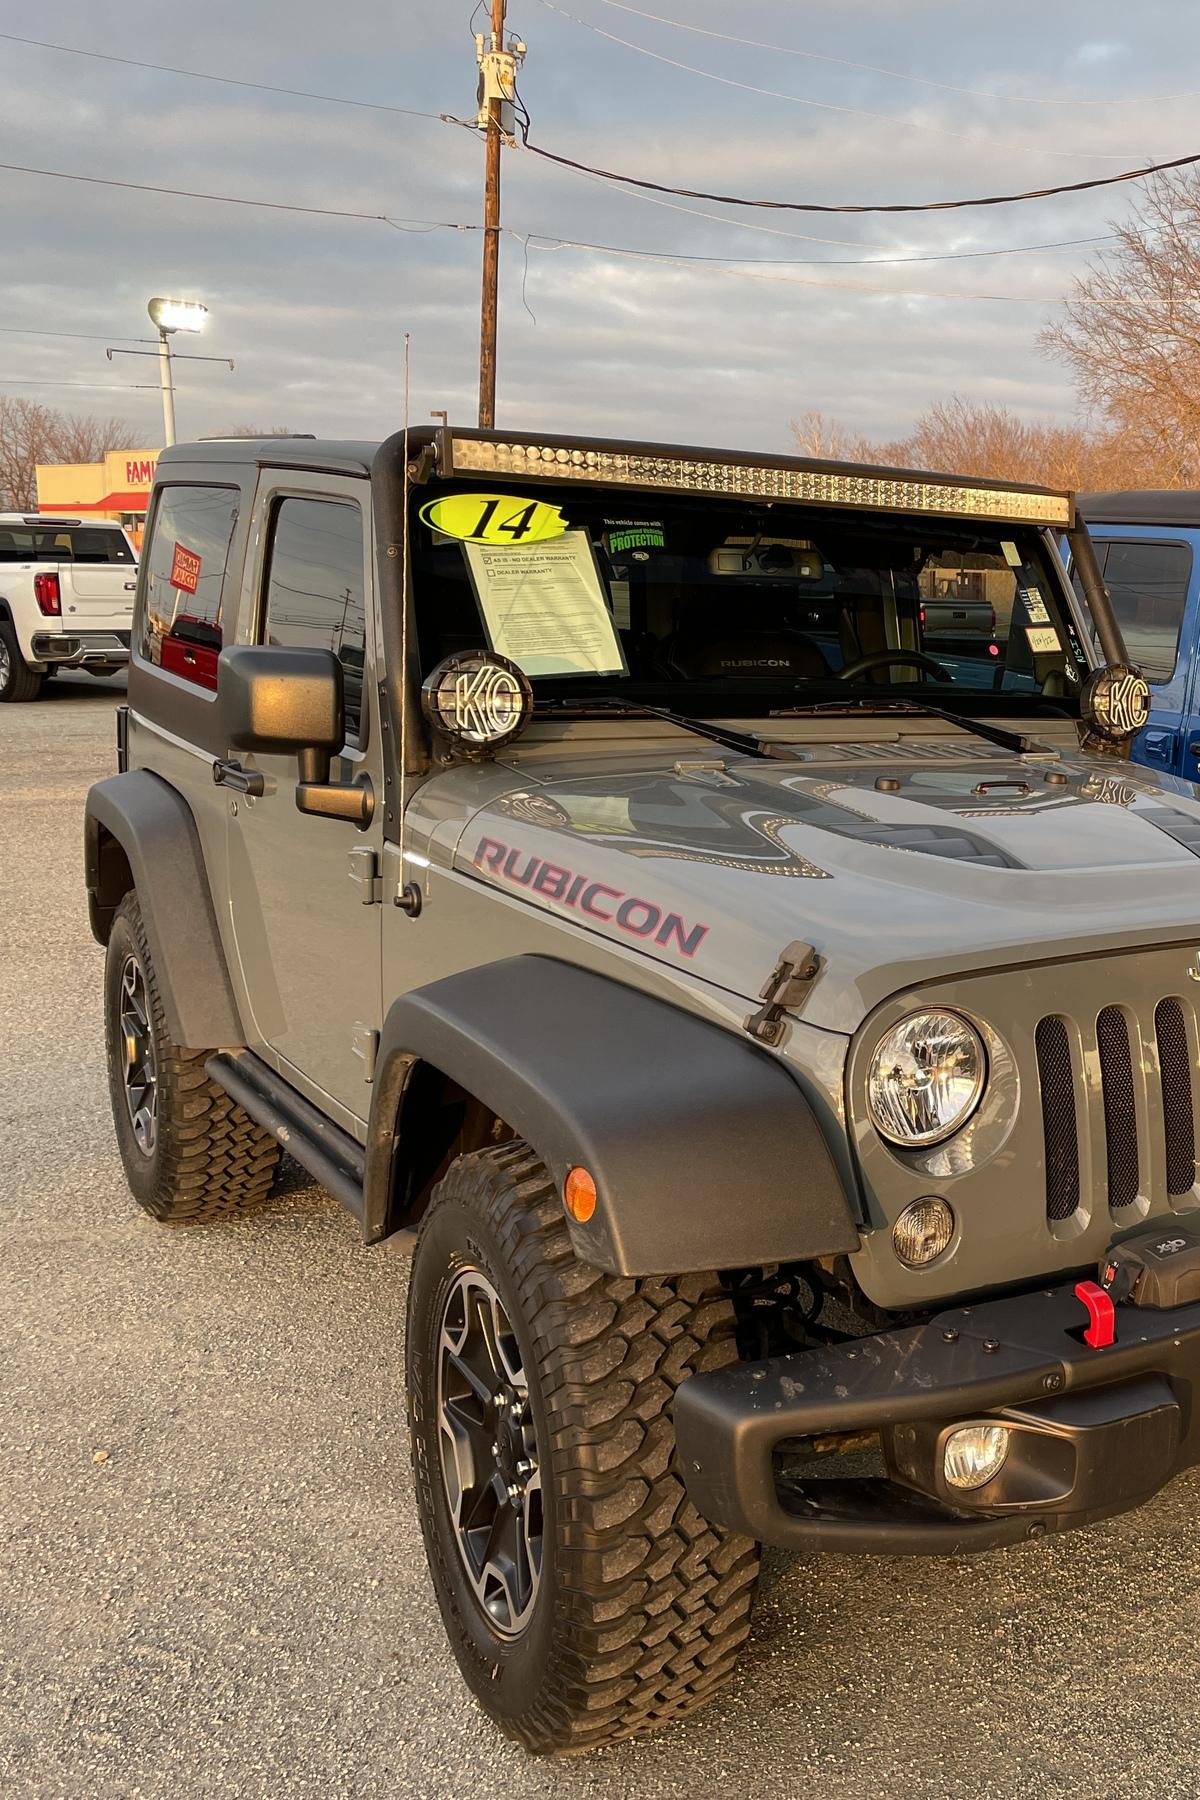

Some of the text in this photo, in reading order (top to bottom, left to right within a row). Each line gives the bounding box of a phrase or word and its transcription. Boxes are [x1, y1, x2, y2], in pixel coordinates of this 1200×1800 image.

[464, 500, 538, 540] 14
[609, 533, 665, 554] PROTECTION
[720, 659, 790, 668] RUBICON
[456, 665, 521, 738] KC
[1110, 674, 1149, 732] KC
[472, 836, 710, 958] RUBICON
